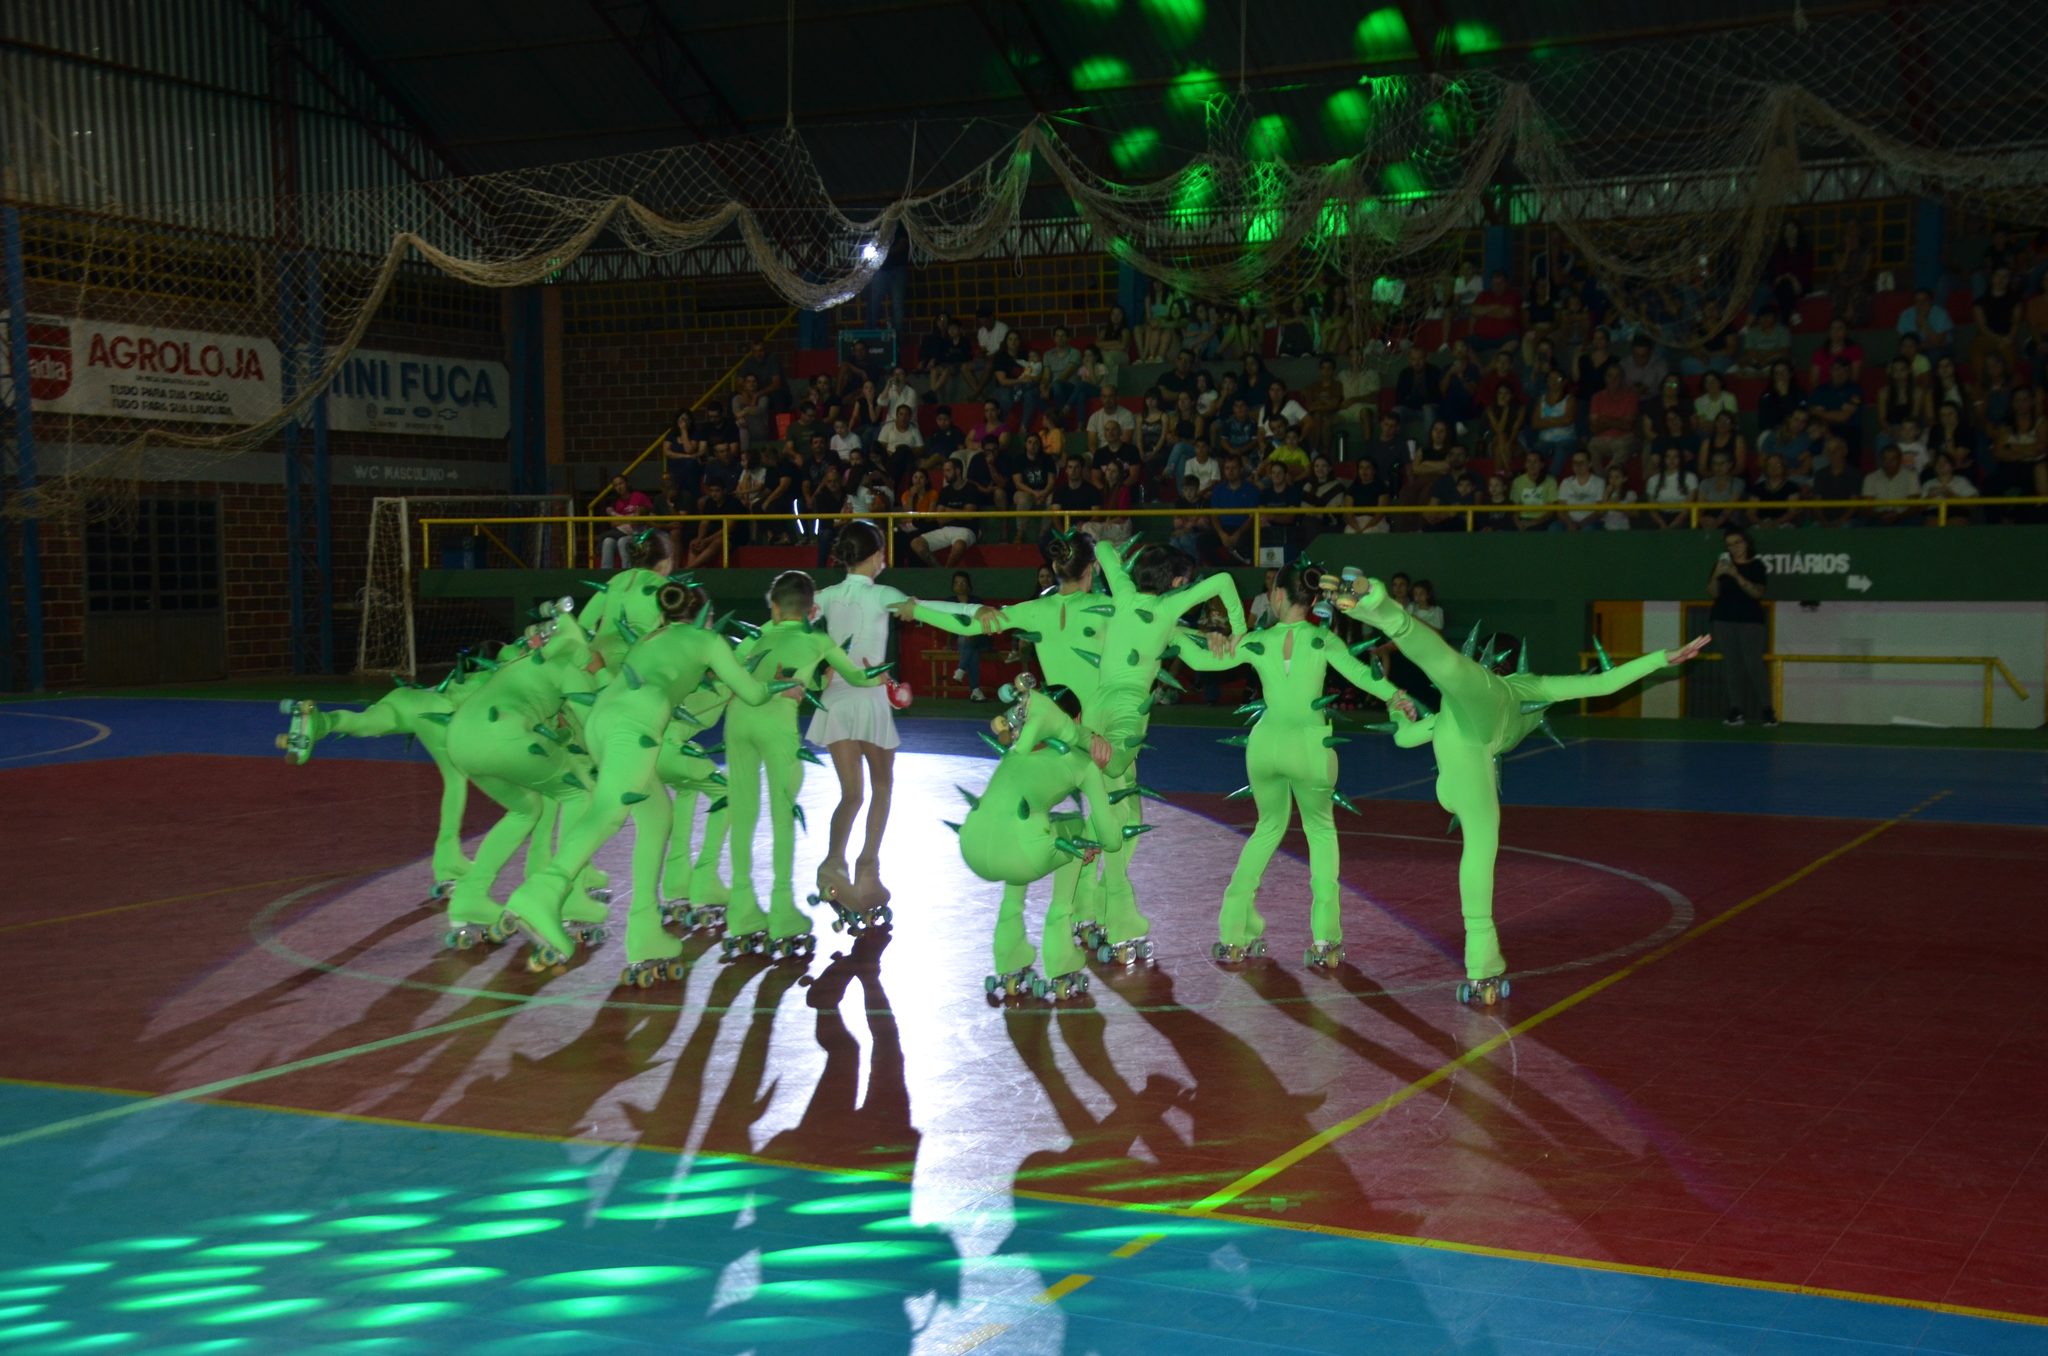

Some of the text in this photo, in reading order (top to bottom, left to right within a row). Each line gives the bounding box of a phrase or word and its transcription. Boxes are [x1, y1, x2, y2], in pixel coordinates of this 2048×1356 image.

[88, 333, 264, 381] AGROLOJA
[110, 385, 138, 396] TUDO
[141, 387, 167, 398] PARA
[169, 389, 187, 399] SUA
[400, 362, 497, 407] FUCA
[112, 399, 139, 409] TUDO
[142, 401, 168, 412] PARA
[170, 403, 190, 413] SUA
[353, 465, 444, 481] WC MASCULINO
[1755, 551, 1850, 574] STIÁRIOS
